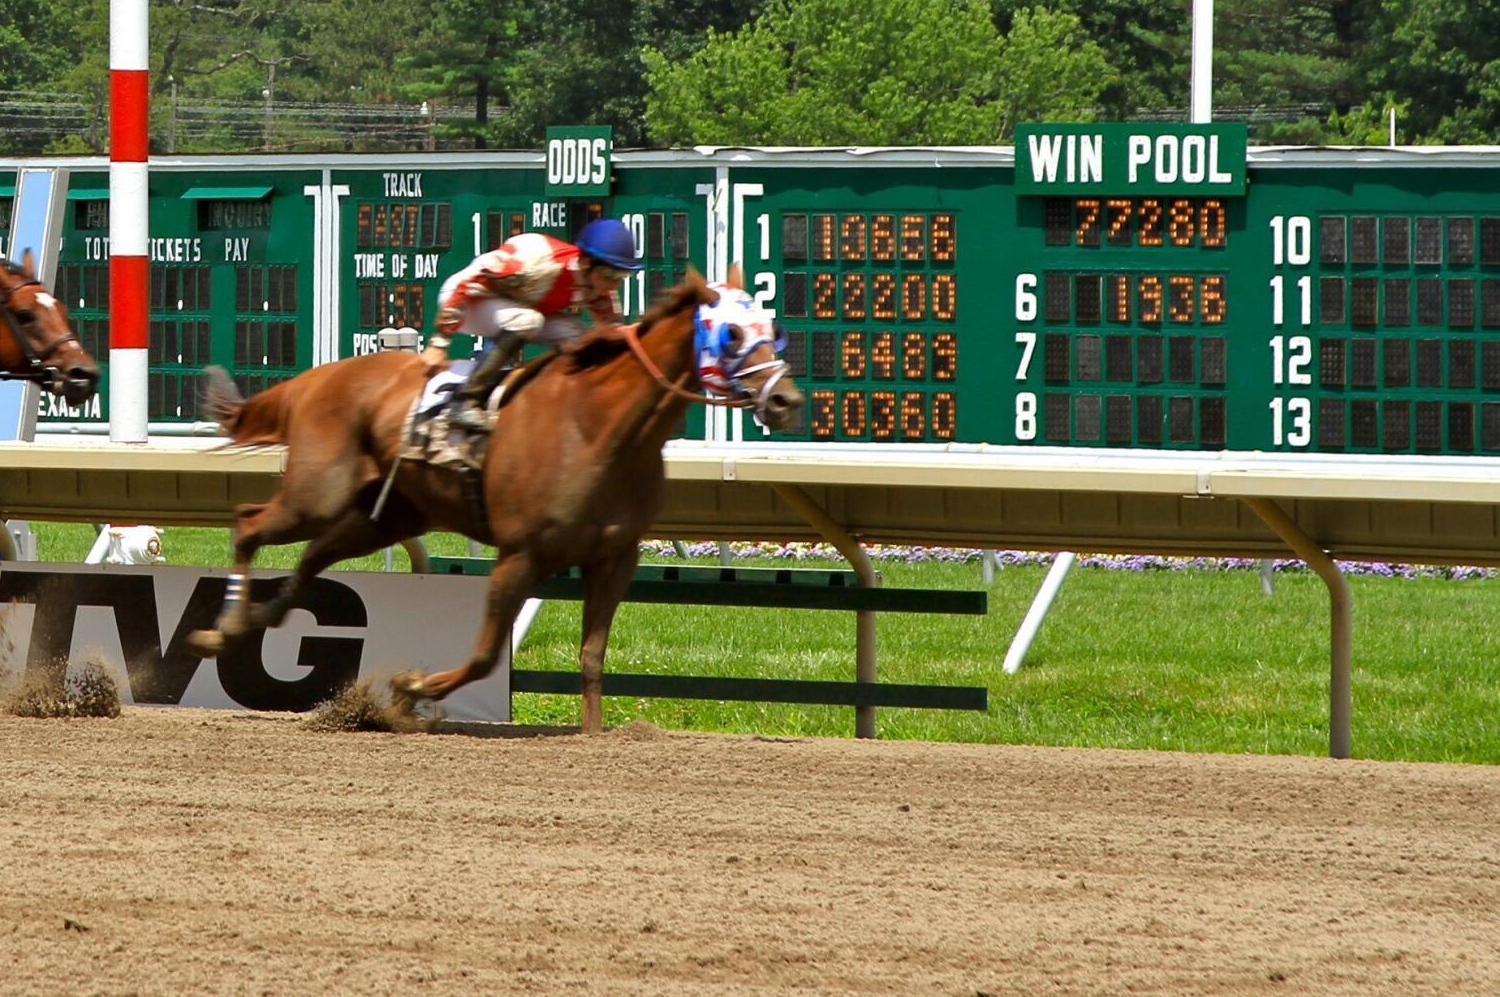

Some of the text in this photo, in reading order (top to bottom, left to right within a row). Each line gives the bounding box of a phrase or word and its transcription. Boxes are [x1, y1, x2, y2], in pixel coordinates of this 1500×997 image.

[548, 138, 607, 185] ODDS
[1028, 135, 1232, 184] WIN POOL
[383, 173, 422, 197] TRACK
[359, 205, 419, 246] FAST
[533, 202, 566, 227] RACE
[757, 214, 770, 259] 1
[1076, 200, 1226, 245] 77280
[148, 238, 201, 262] ICKETS
[225, 238, 250, 261] PAY
[1269, 215, 1311, 265] 10
[354, 254, 439, 278] TIME OF DAY
[622, 270, 645, 316] 11
[754, 272, 777, 319] 2
[812, 273, 956, 319] 22200
[1015, 273, 1038, 321] 6
[1117, 277, 1226, 322] 1936
[1269, 275, 1311, 325] 11
[1015, 332, 1037, 380] 7
[1269, 336, 1312, 385] 12
[811, 390, 956, 437] 30360
[1015, 392, 1038, 440] 8
[1269, 397, 1311, 447] 13
